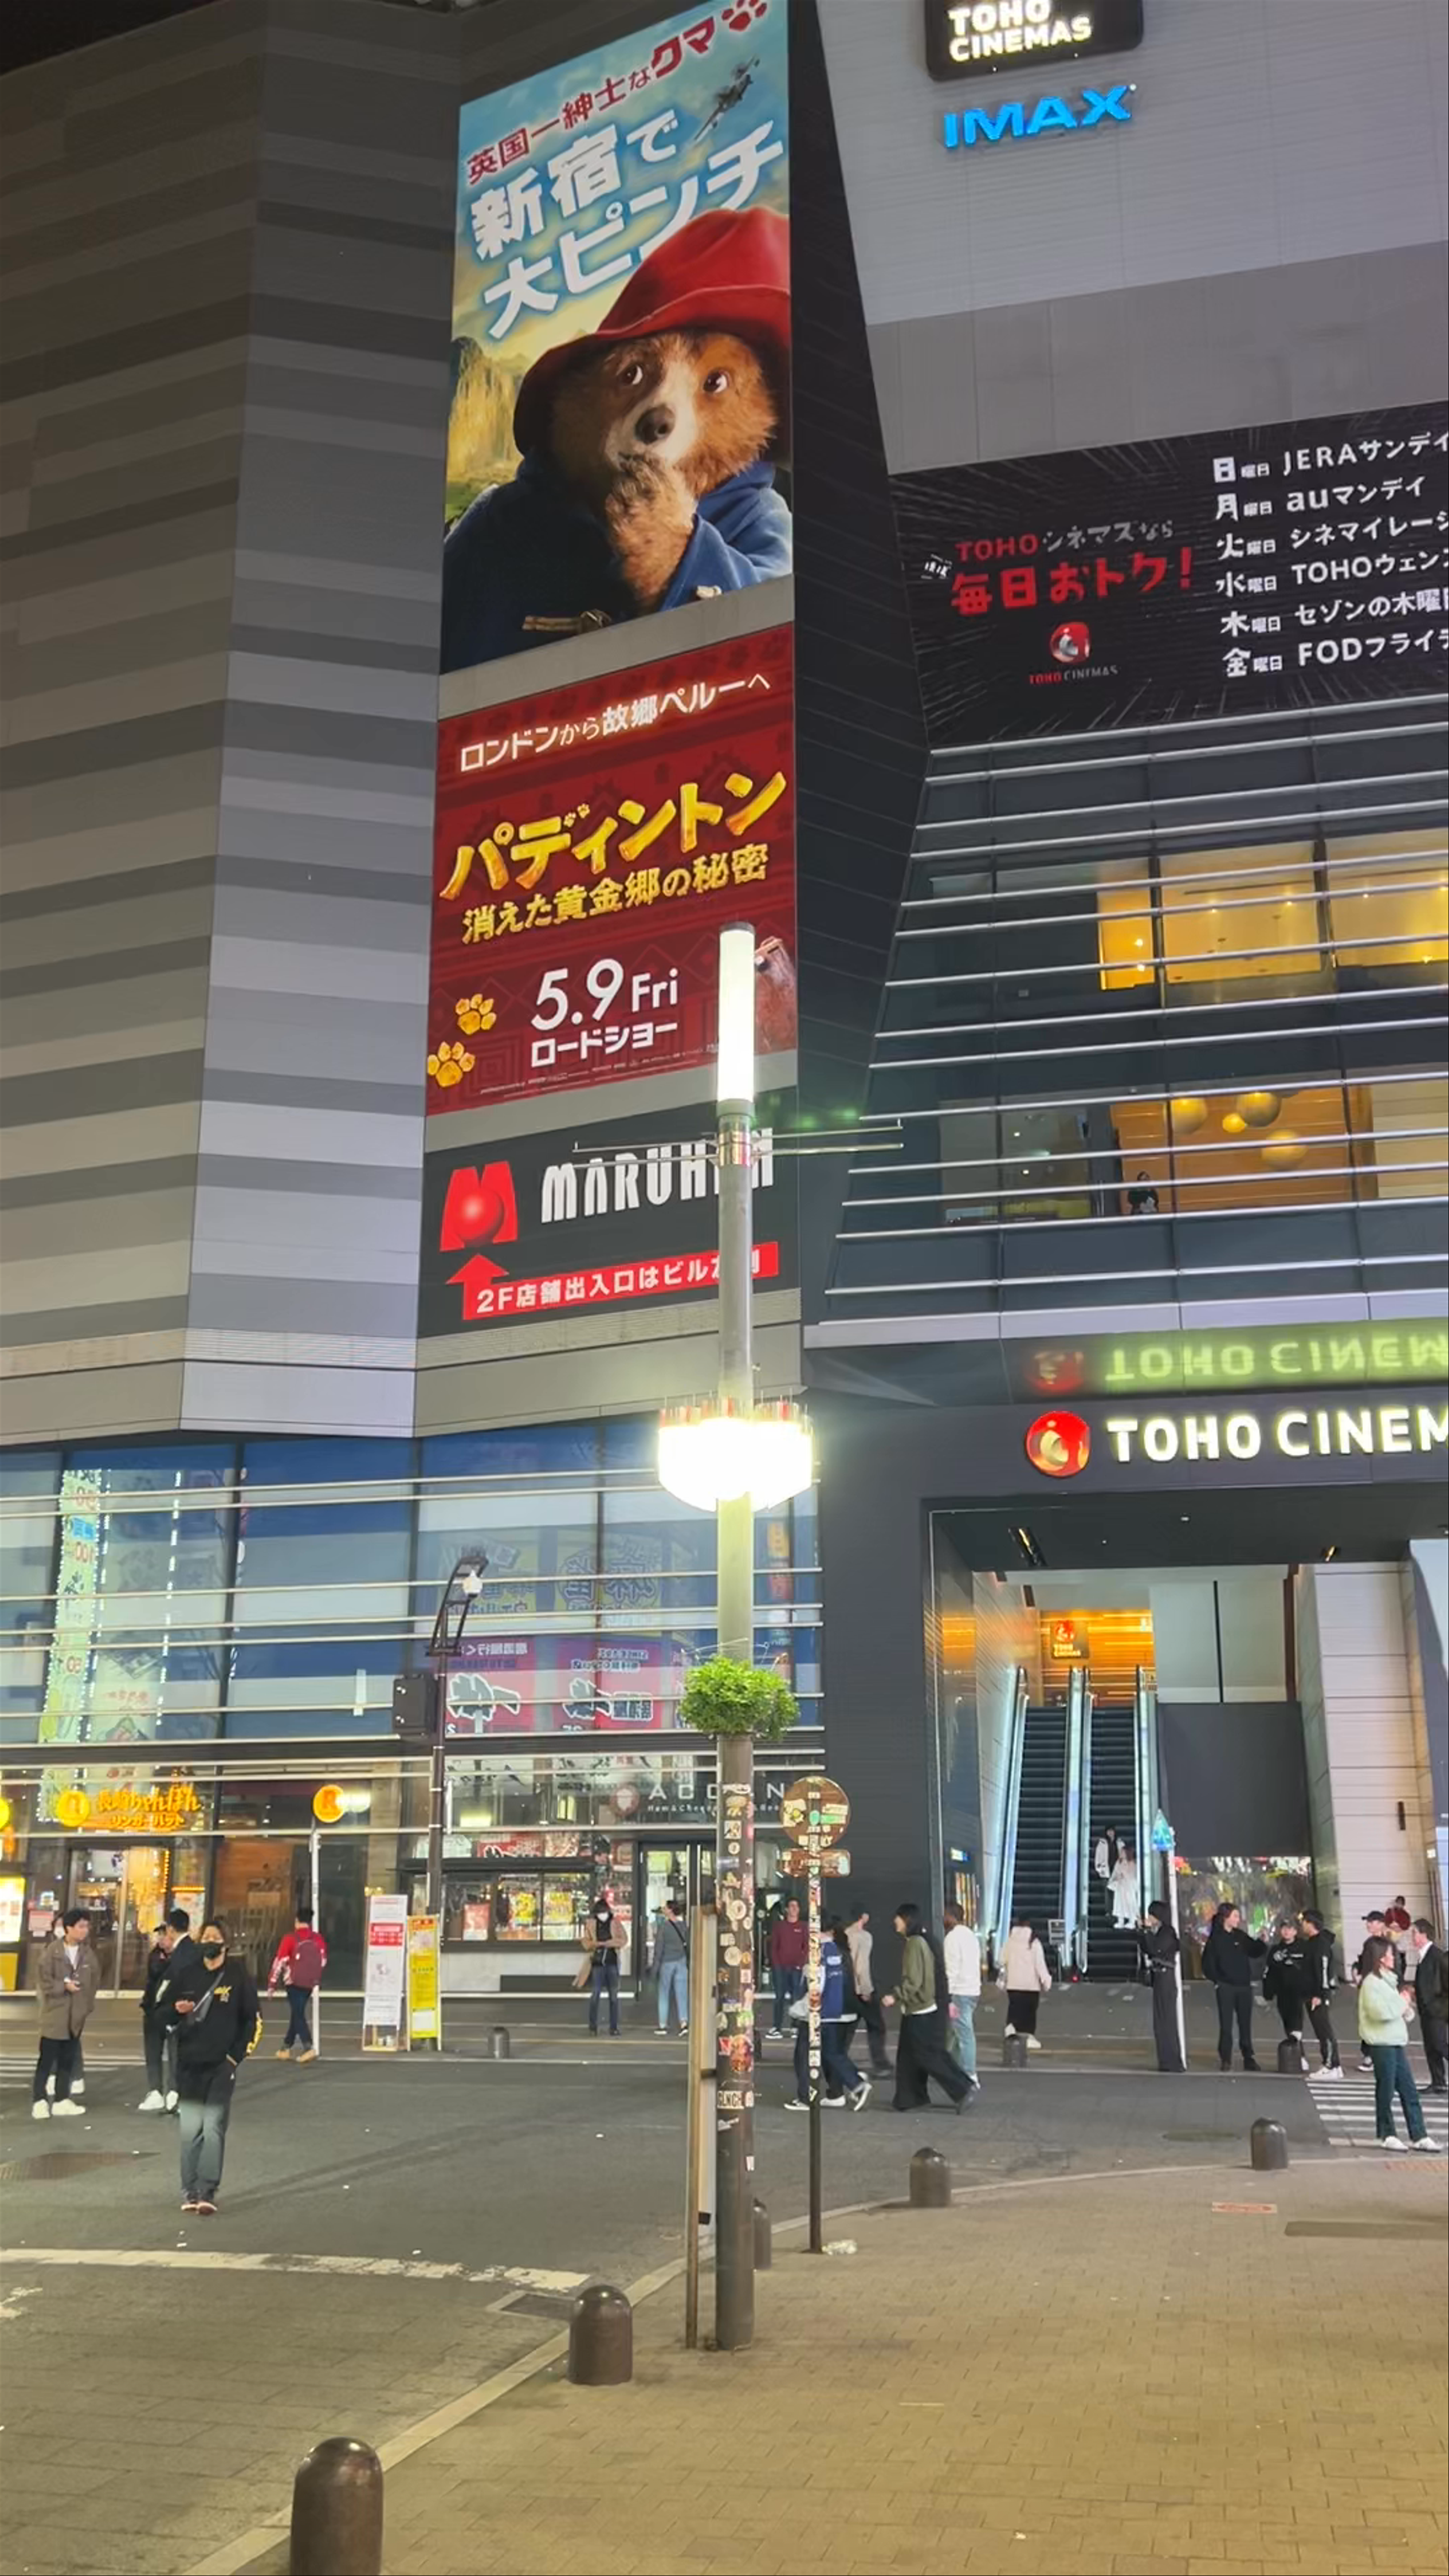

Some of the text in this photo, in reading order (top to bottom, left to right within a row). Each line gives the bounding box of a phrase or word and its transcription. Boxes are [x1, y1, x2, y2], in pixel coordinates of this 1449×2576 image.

[948, 0, 1051, 35] TOHO
[949, 14, 1092, 62] CINEMAS
[467, 16, 714, 185] 英国一紳士なクマ
[944, 85, 1131, 148] IMAX
[470, 109, 678, 260] 新宿で
[484, 120, 783, 339] 大ピンチ
[1213, 457, 1270, 483] 日曜日
[1216, 477, 1425, 521] 月曜日 auマンデイ
[1217, 533, 1276, 560] 火曜日
[1216, 572, 1277, 597] 水曜日
[1221, 611, 1281, 637] 木曜日
[1222, 647, 1283, 678] 金曜日
[461, 674, 771, 772] ロンドンから故郷ペルーへ
[440, 771, 786, 899] パディントン
[462, 844, 769, 944] 消えた黄金郷の秘密
[532, 958, 678, 1031] 5.9 Fri
[532, 1022, 678, 1067] ロードショー
[541, 1127, 774, 1223] MARUHN
[1106, 1406, 1448, 1463] TOHO CINEM
